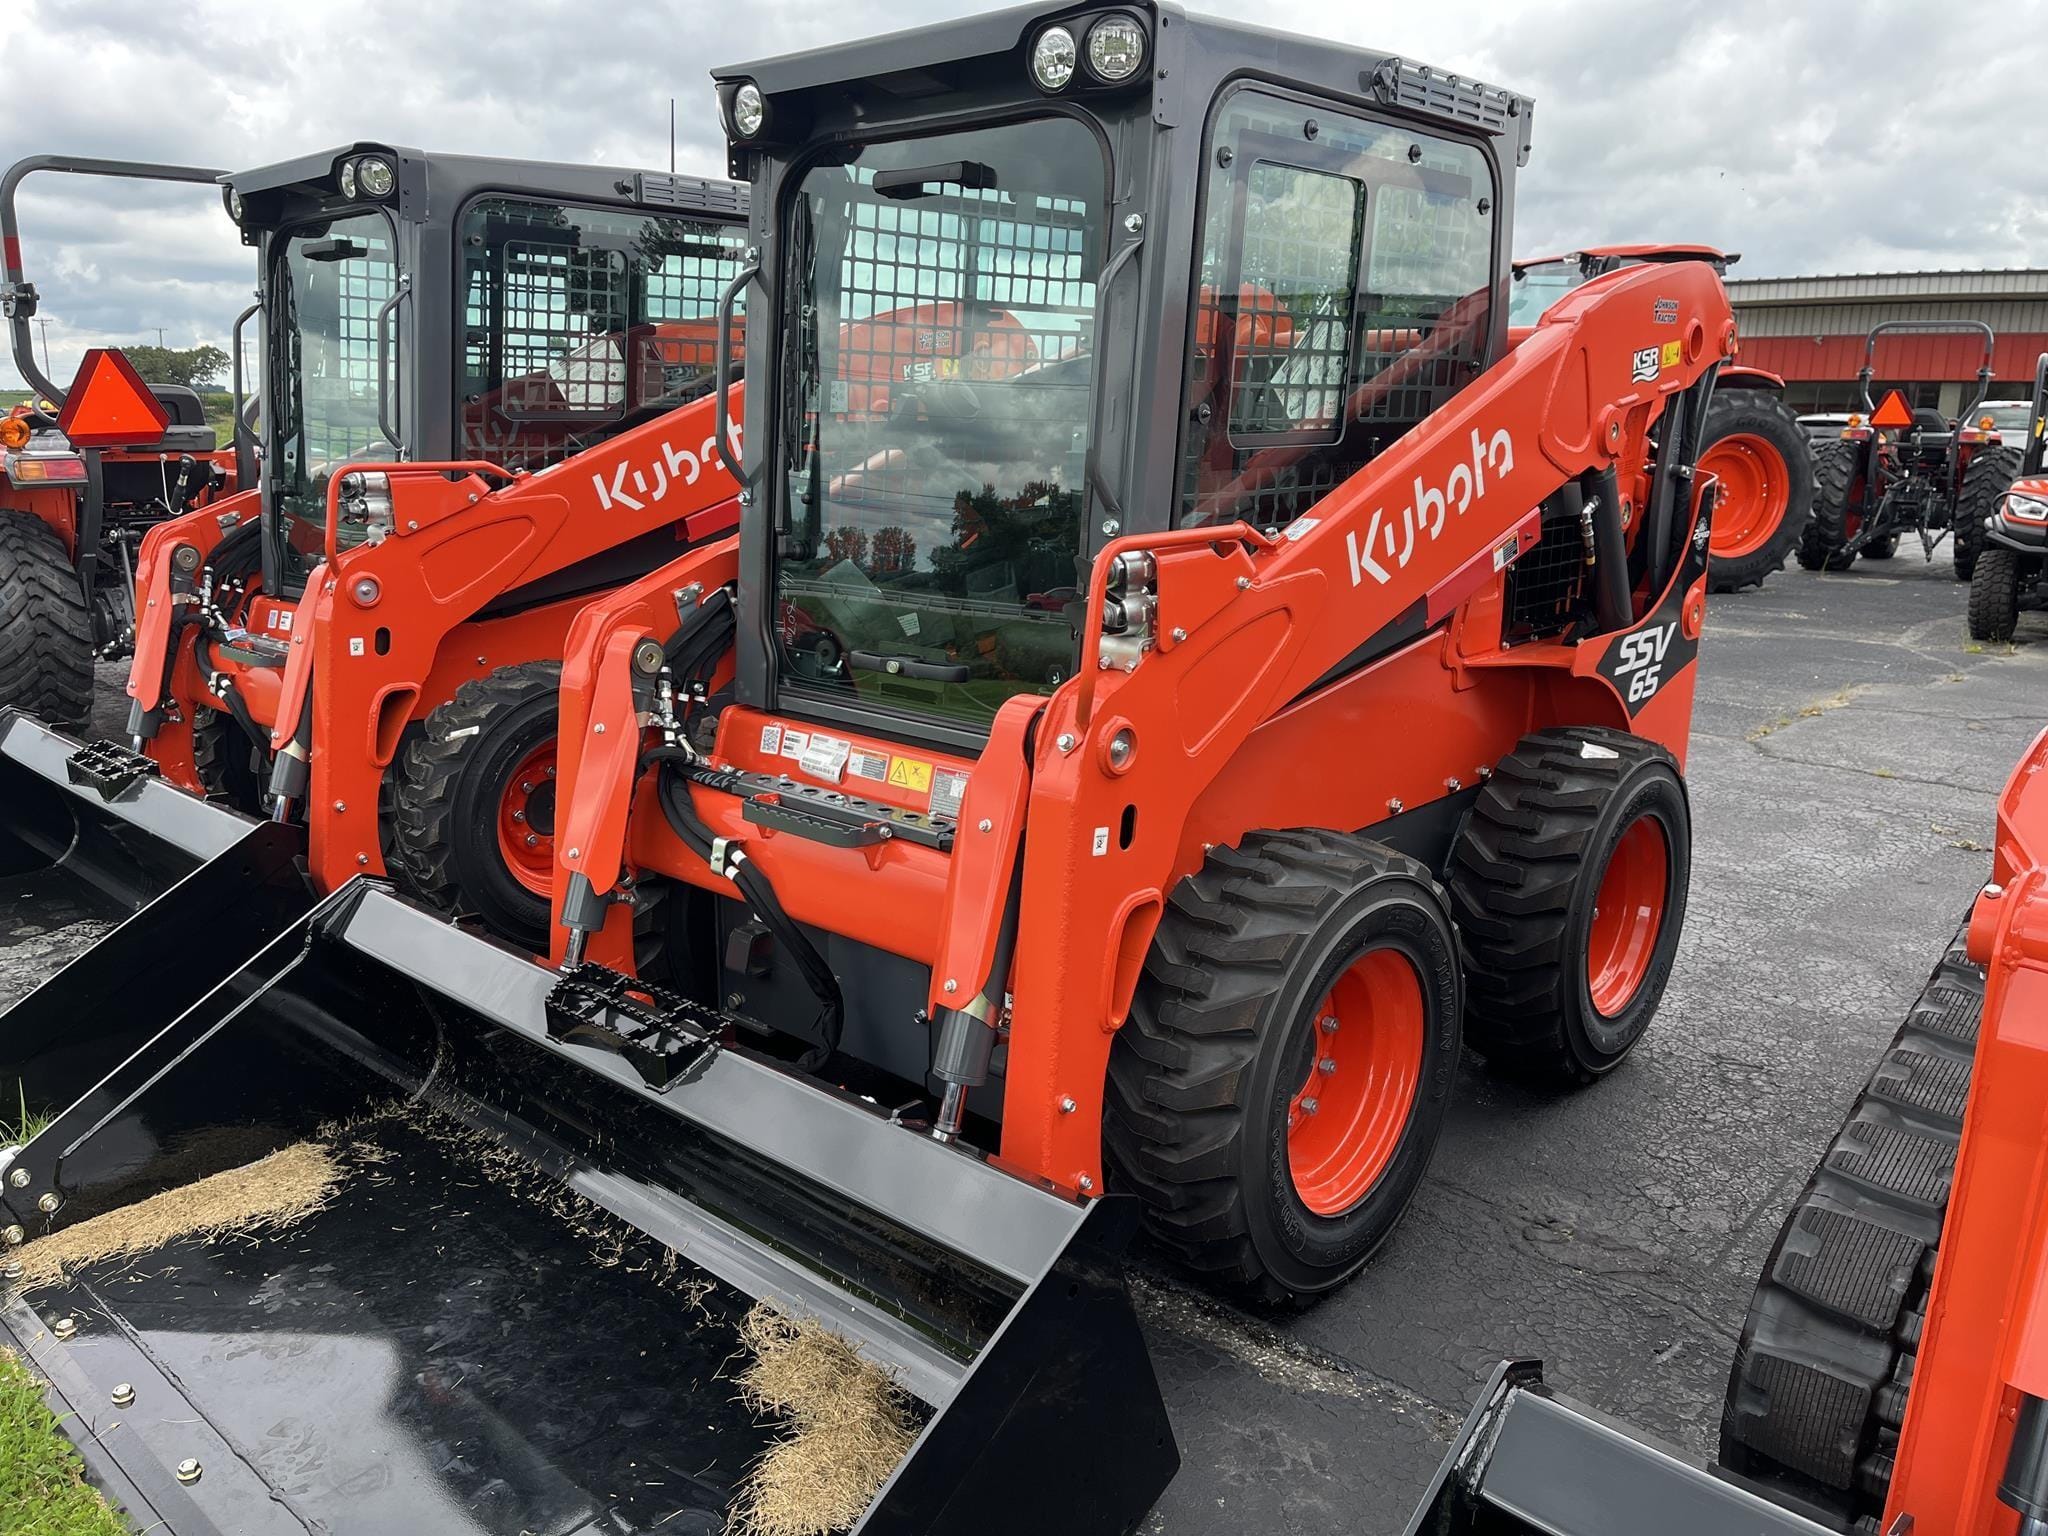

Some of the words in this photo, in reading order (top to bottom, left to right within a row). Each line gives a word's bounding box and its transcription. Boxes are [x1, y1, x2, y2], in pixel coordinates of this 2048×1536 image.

[1654, 297, 1678, 310] JOHNSON
[1654, 310, 1678, 323] TRACTOR
[1632, 346, 1659, 371] KSR
[592, 412, 743, 511] Kubot
[1346, 427, 1514, 588] Kubota
[1614, 621, 1677, 676] SSV
[1628, 664, 1662, 703] 65
